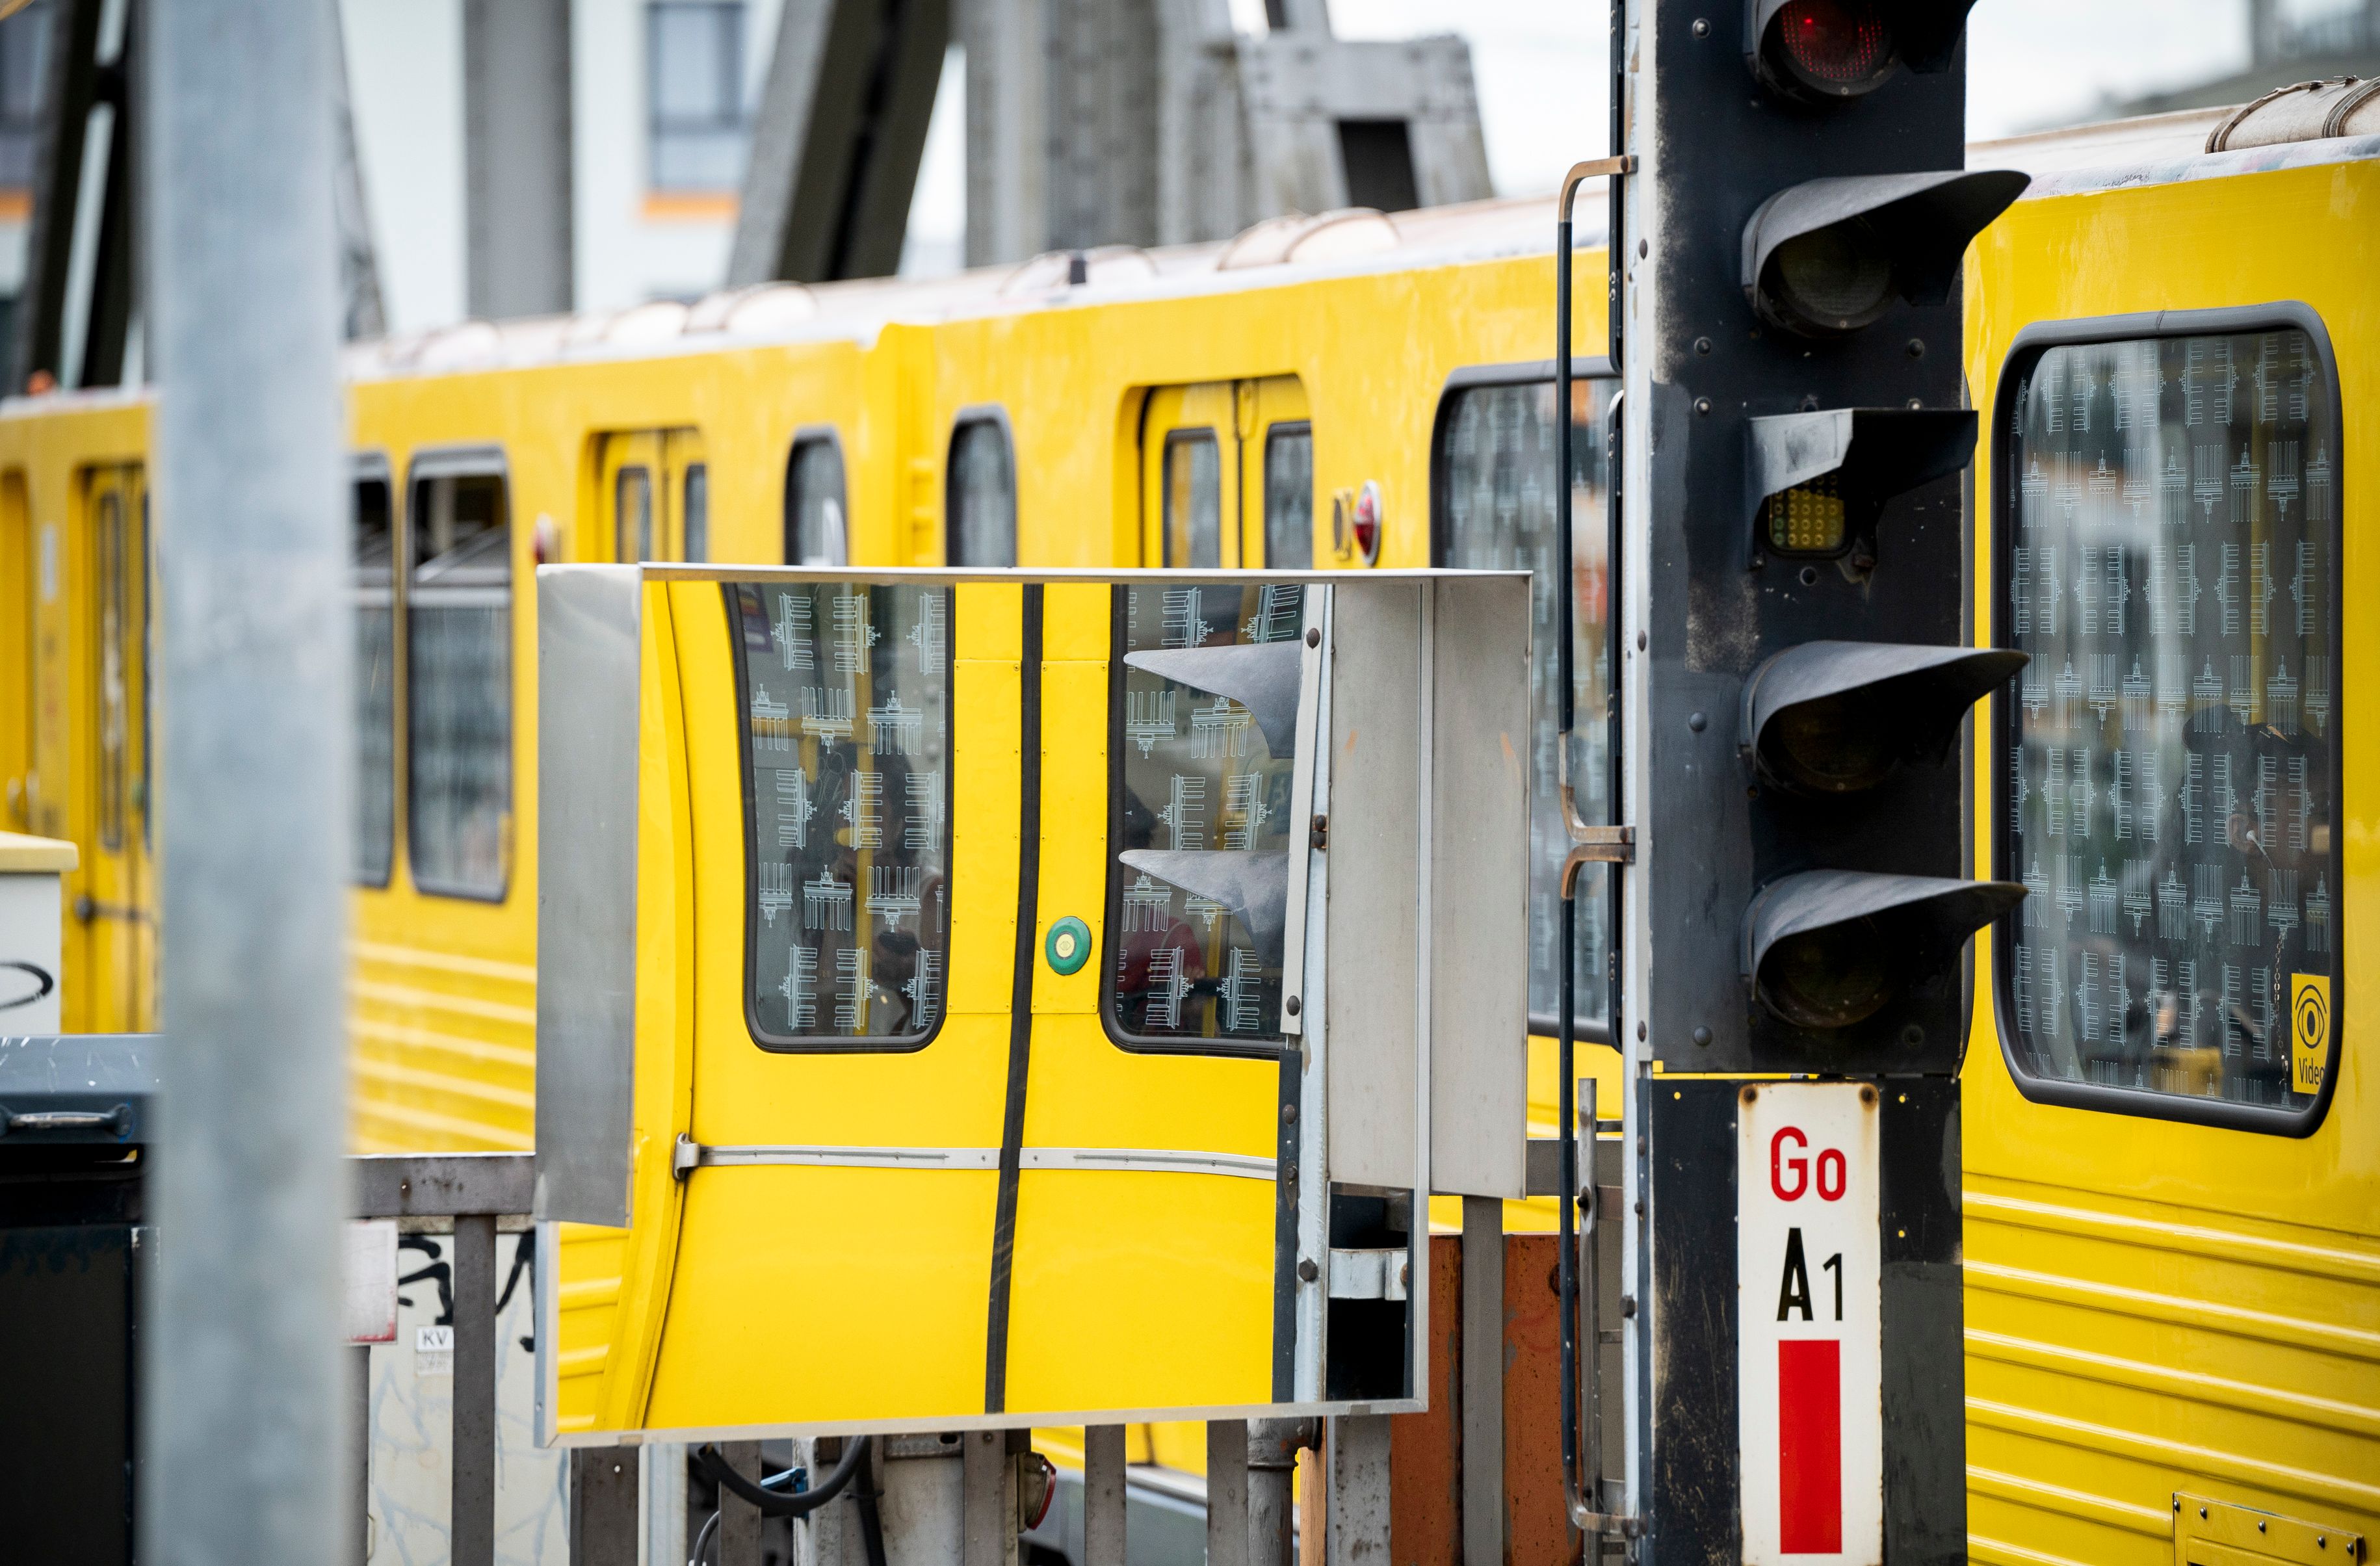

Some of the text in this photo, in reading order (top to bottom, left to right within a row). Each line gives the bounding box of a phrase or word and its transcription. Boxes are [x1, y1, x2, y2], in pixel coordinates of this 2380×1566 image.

[1771, 1126, 1846, 1201] Go
[1777, 1227, 1842, 1322] A1
[423, 1331, 448, 1346] KV
